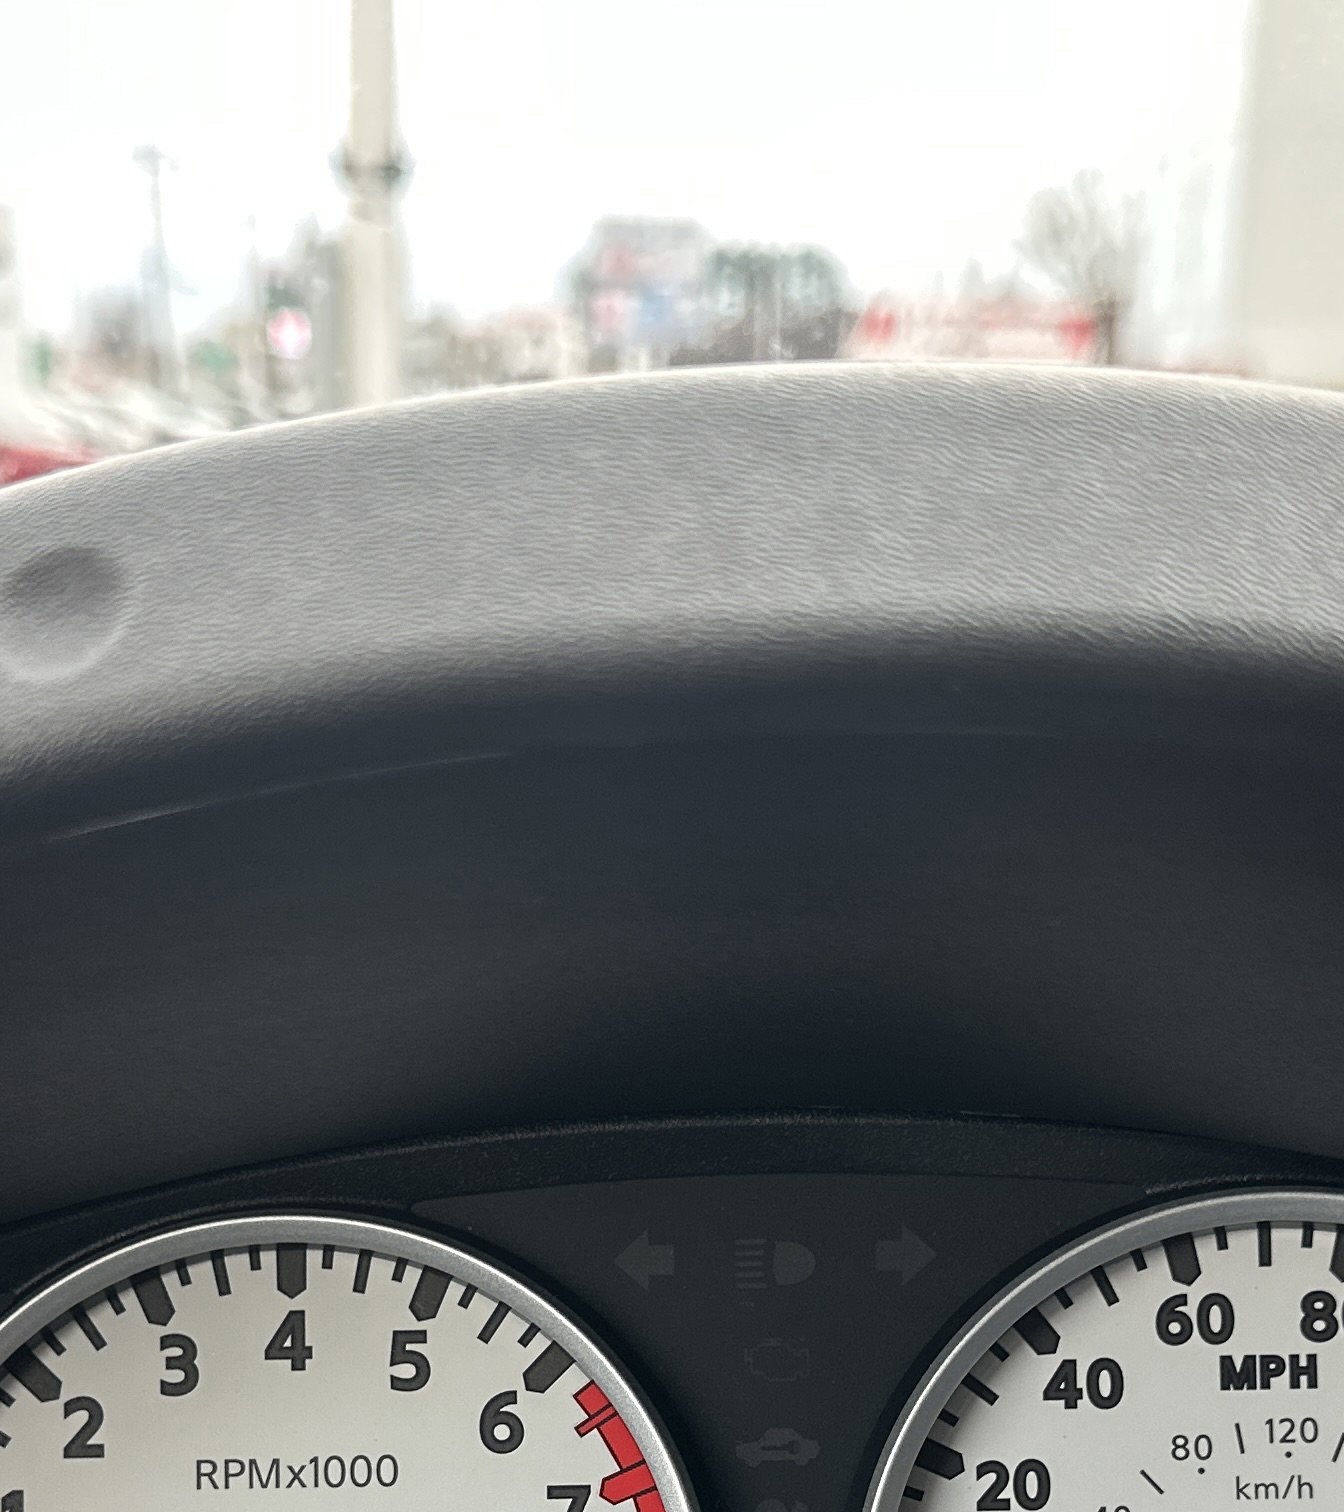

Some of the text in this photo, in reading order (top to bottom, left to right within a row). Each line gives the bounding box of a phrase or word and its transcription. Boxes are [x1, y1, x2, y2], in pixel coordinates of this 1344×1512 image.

[264, 1309, 313, 1372] 4
[1155, 1292, 1236, 1347] 60
[159, 1333, 200, 1397] 3
[389, 1329, 432, 1393] 5
[1042, 1357, 1125, 1410] 40
[1219, 1353, 1319, 1392] MPH
[62, 1395, 105, 1459] 2
[478, 1389, 526, 1455] 6
[1170, 1434, 1213, 1462] 80
[1264, 1416, 1319, 1444] 120
[195, 1454, 399, 1491] RPMx1000
[975, 1458, 1051, 1512] 20
[1235, 1474, 1314, 1501] km/h
